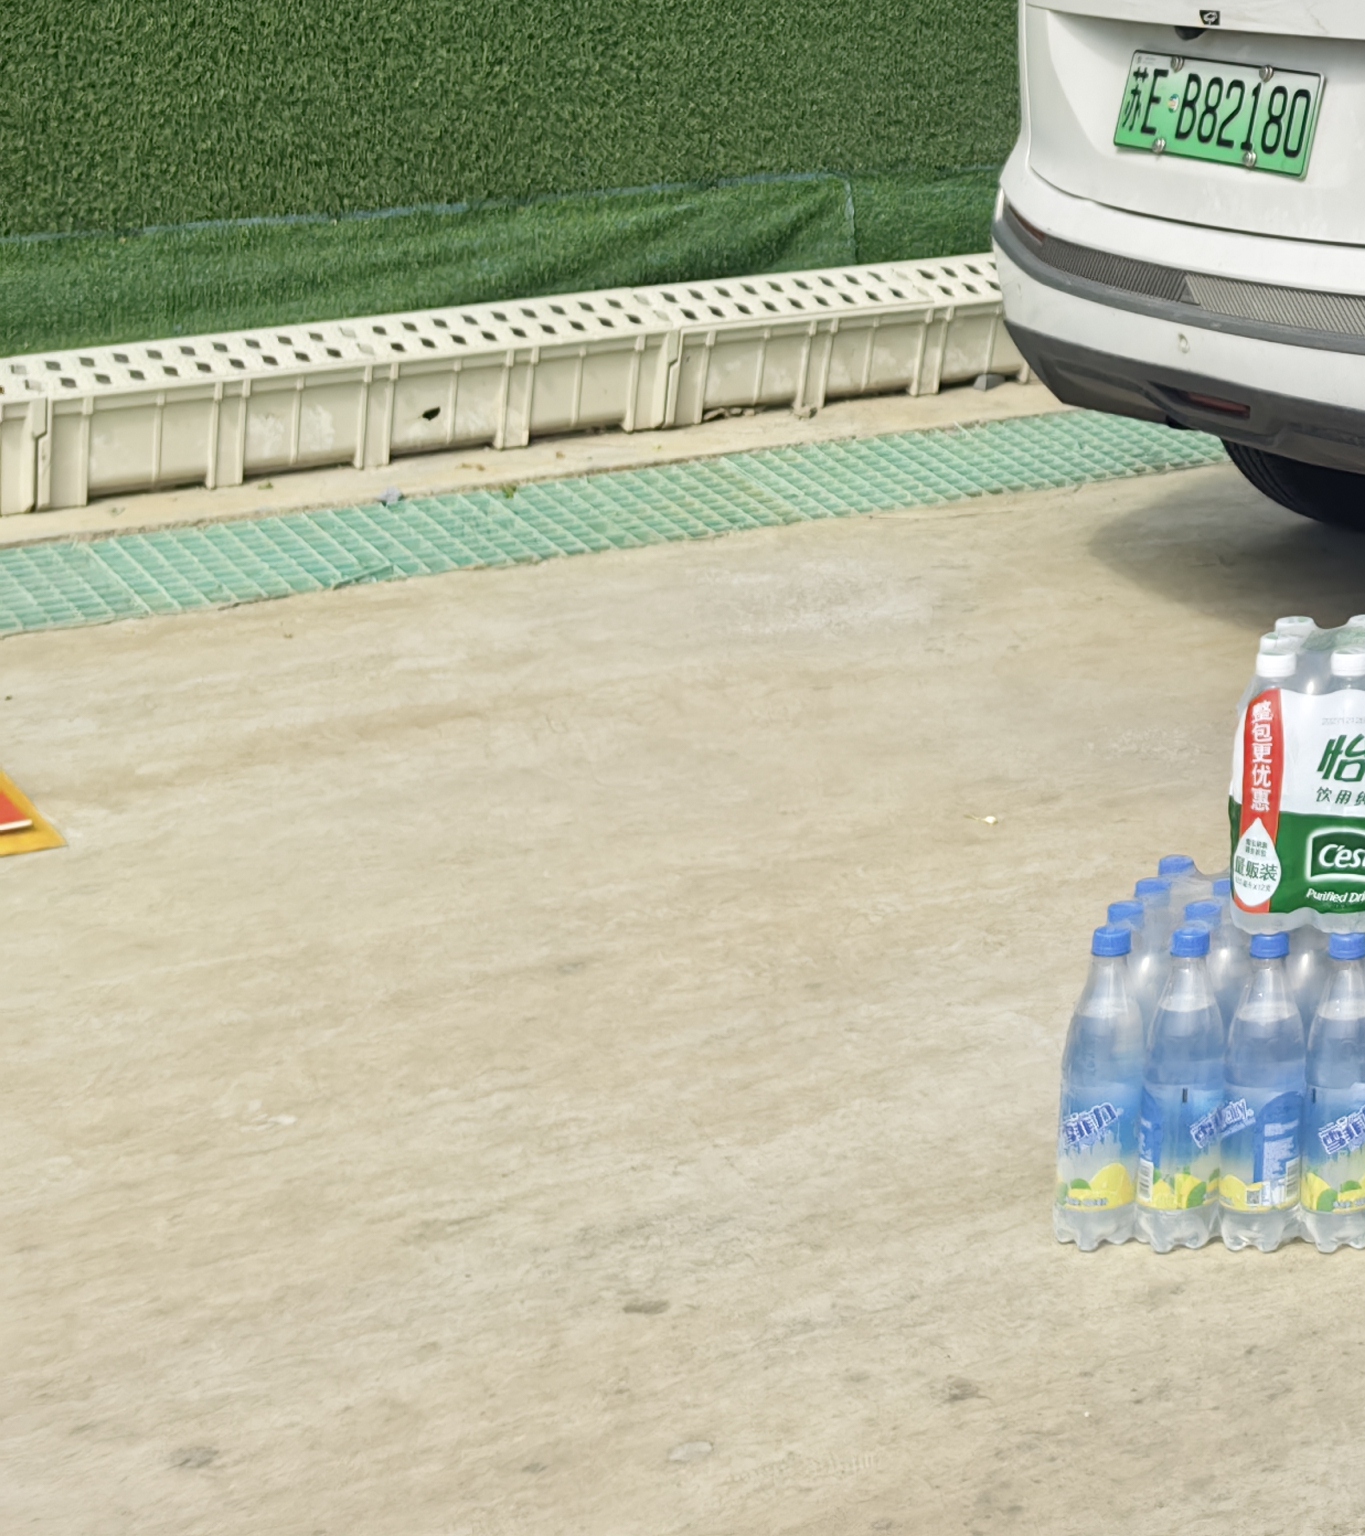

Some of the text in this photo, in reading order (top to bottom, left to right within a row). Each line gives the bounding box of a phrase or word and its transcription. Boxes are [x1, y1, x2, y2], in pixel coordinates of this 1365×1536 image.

[1250, 700, 1274, 813] 整包更优惠
[1305, 887, 1347, 903] Purified
